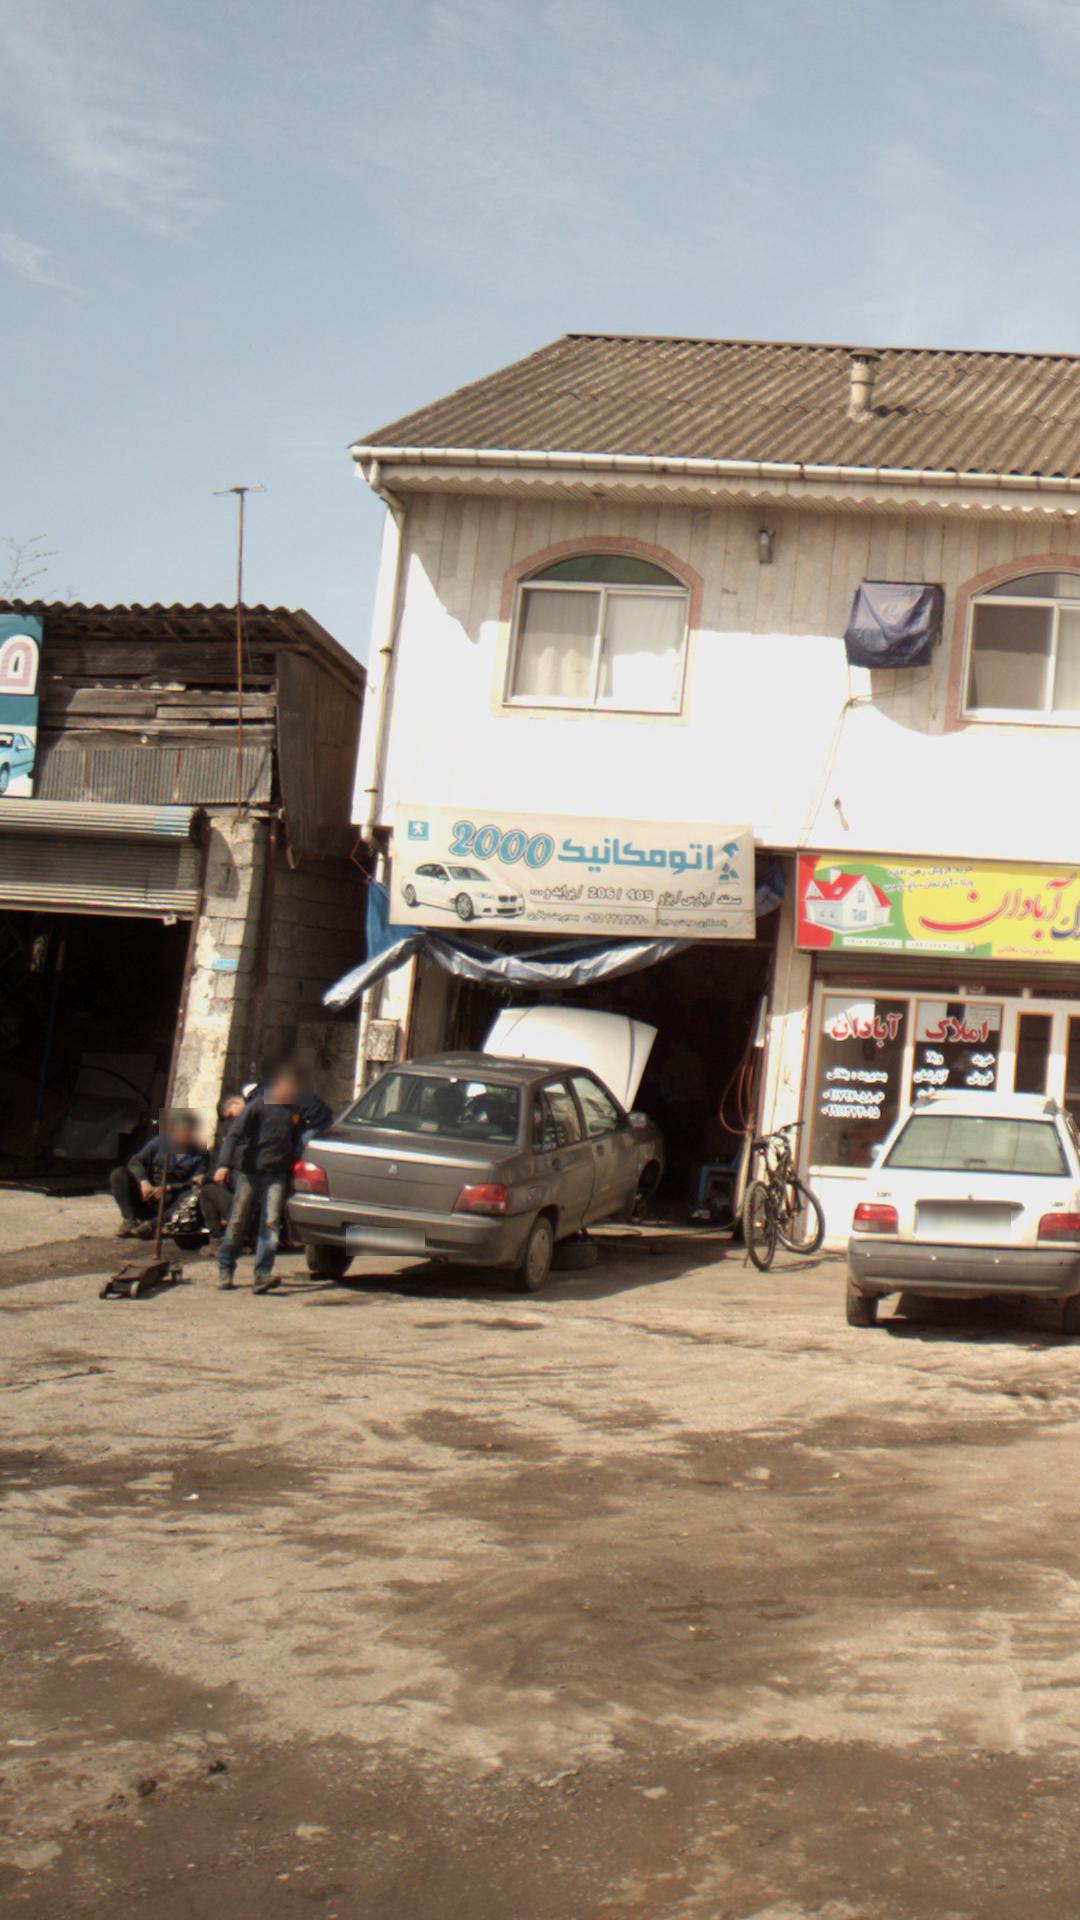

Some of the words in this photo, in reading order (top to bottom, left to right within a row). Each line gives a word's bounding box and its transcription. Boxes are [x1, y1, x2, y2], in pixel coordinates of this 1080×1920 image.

[449, 820, 555, 869] 2000
[557, 838, 714, 876] اتومکانیک
[587, 885, 616, 900] 206
[830, 1012, 903, 1048] آبادان
[925, 1016, 990, 1043] املاک
